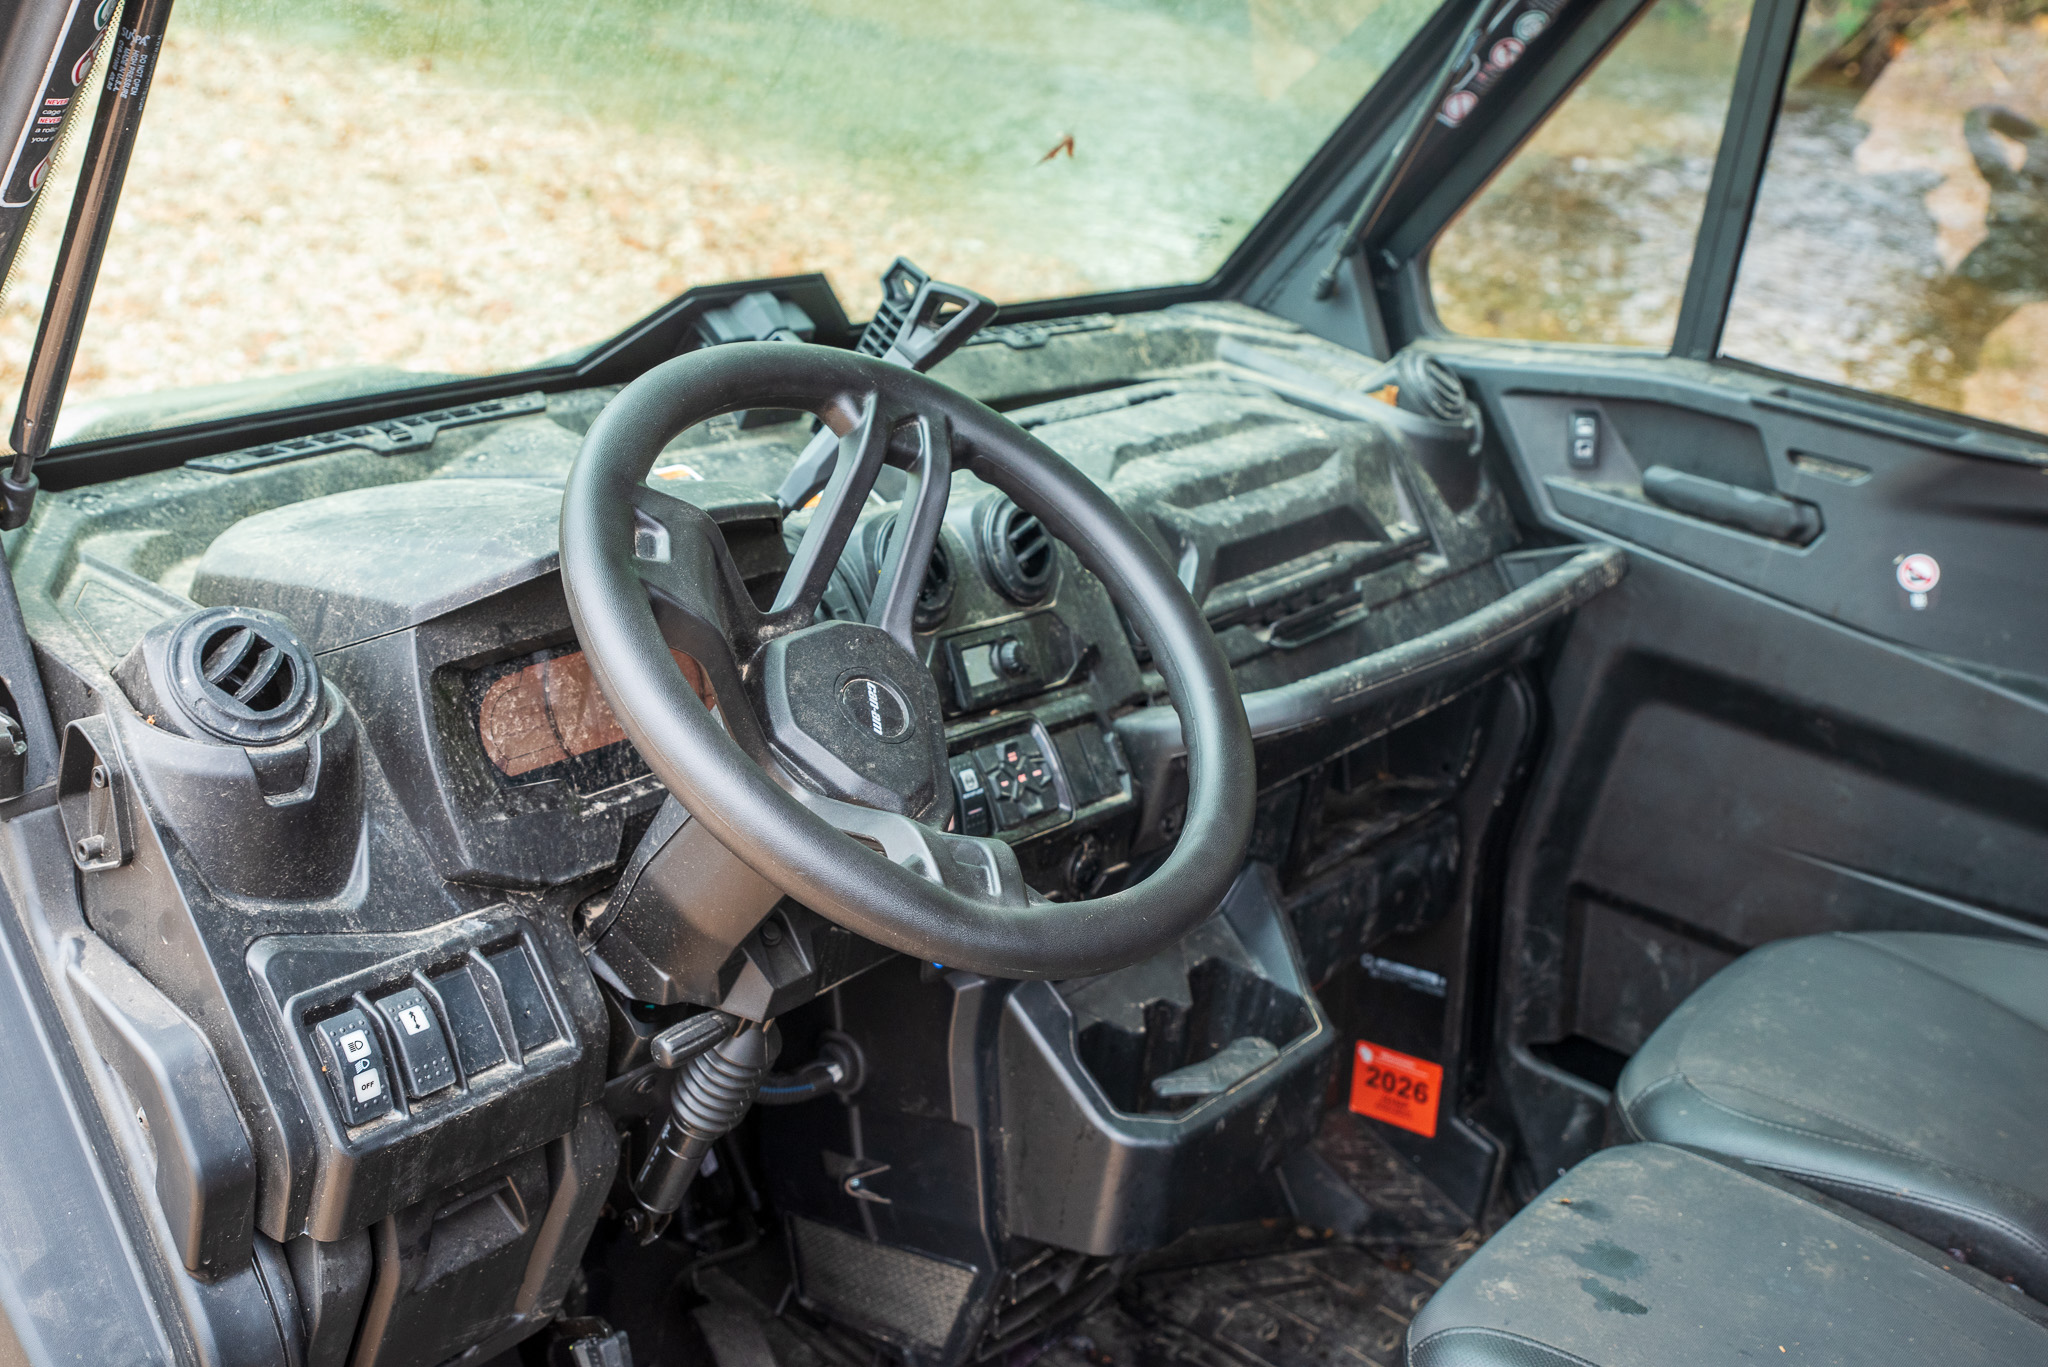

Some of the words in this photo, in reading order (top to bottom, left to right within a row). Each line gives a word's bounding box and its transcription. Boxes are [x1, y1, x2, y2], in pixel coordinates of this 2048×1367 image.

[120, 47, 131, 66] MADE
[130, 49, 140, 66] HIGH
[140, 54, 148, 64] DO
[119, 65, 126, 73] IN
[136, 65, 145, 78] NOT
[120, 65, 136, 99] PRESSURE
[130, 78, 141, 96] OPEN
[866, 681, 883, 736] can-am
[361, 1080, 375, 1091] OFF
[1365, 1065, 1429, 1105] 2026
